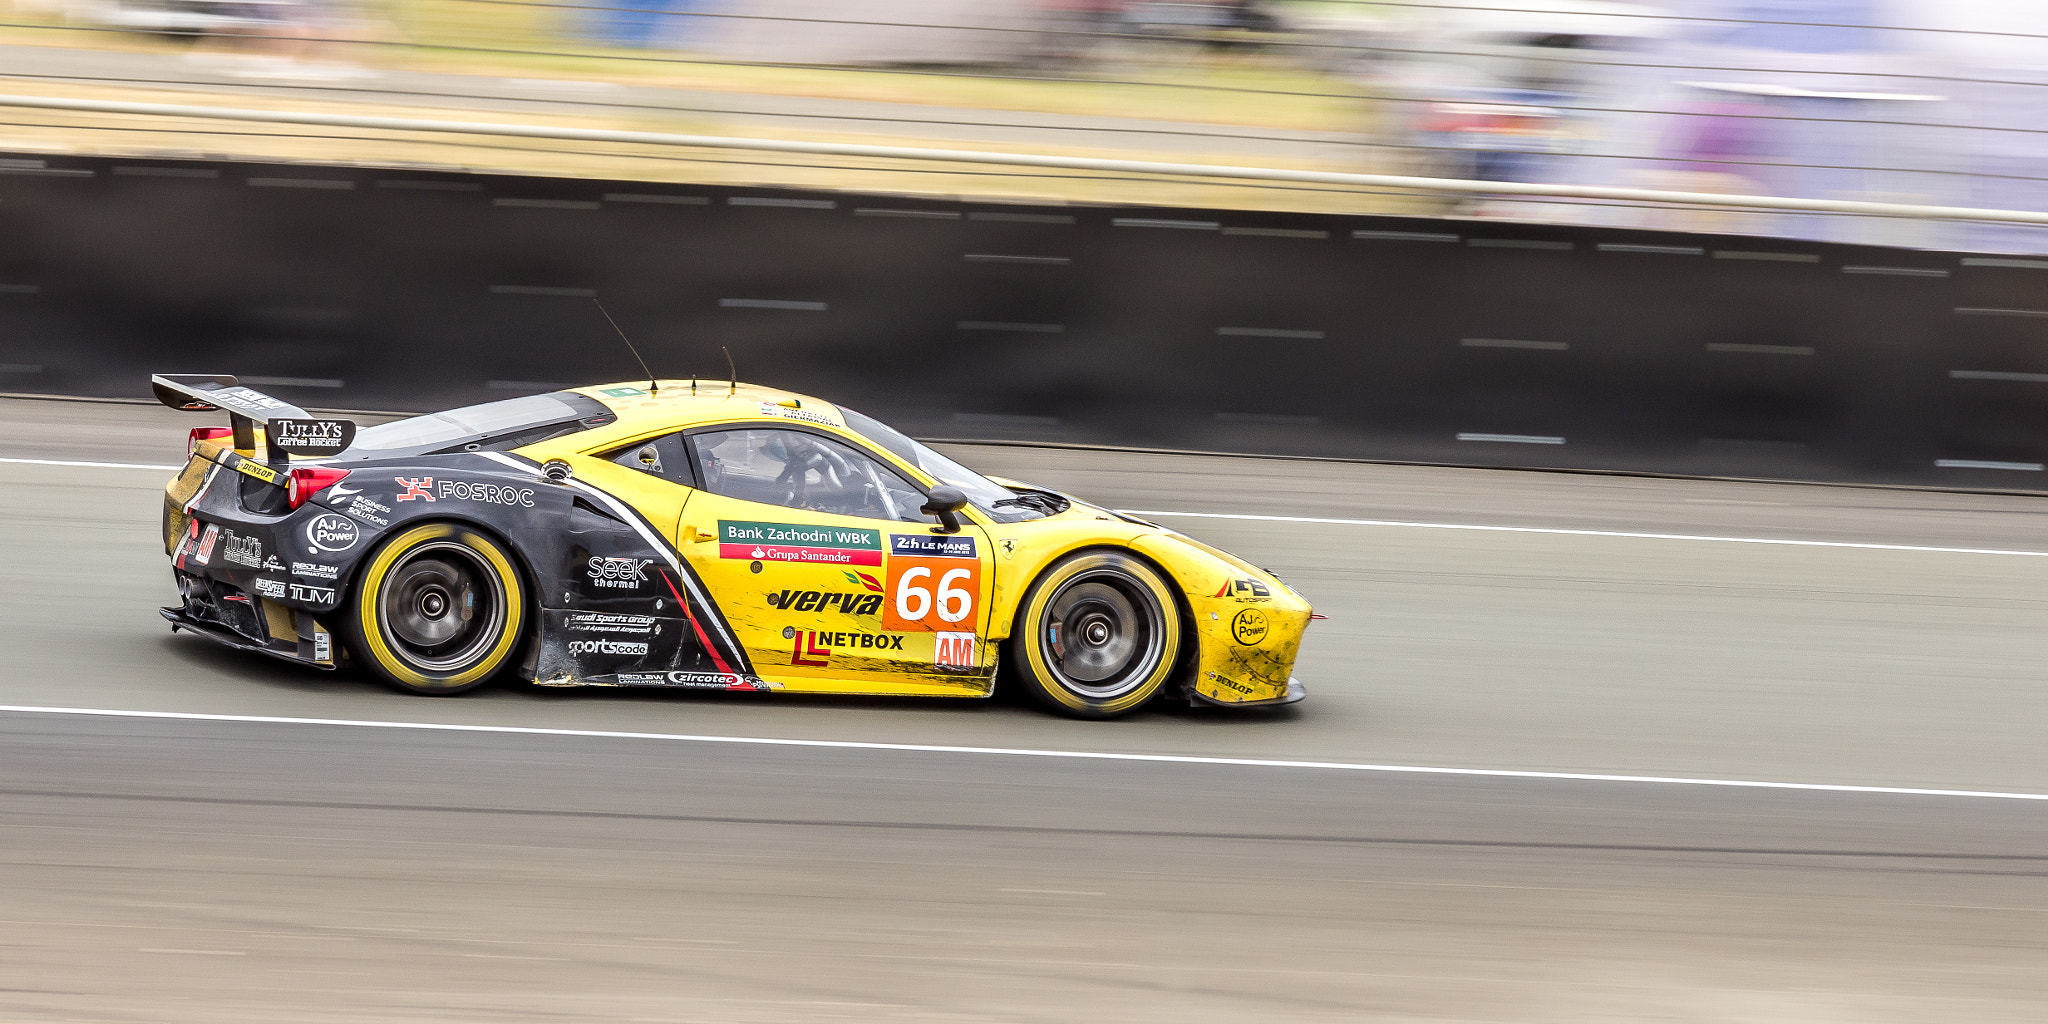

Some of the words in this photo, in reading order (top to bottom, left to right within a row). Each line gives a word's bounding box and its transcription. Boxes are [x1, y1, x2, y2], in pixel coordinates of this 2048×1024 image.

[243, 463, 272, 478] DUNLOP
[437, 480, 535, 507] FOSROC
[351, 500, 377, 514] SPORT
[355, 495, 391, 513] BUSINESS
[317, 518, 337, 530] AJ
[347, 507, 389, 526] SOLUTIONS
[316, 530, 354, 542] Power
[728, 526, 763, 540] Bank
[766, 527, 832, 543] Zachodni
[835, 530, 872, 545] WBK
[921, 542, 936, 550] LE
[937, 542, 971, 551] MANS
[767, 548, 800, 562] Grupa
[801, 550, 851, 563] Santander
[594, 578, 640, 589] thermal
[289, 583, 335, 604] TUMI
[895, 566, 973, 623] 66
[777, 589, 884, 616] verva
[596, 614, 627, 624] Sports
[627, 616, 656, 625] Group
[1239, 613, 1253, 625] AJ
[1239, 625, 1265, 638] Power
[819, 631, 904, 651] NETBOX
[938, 637, 972, 667] AM
[679, 673, 734, 683] zircotec
[1215, 674, 1253, 695] DUNLOP
